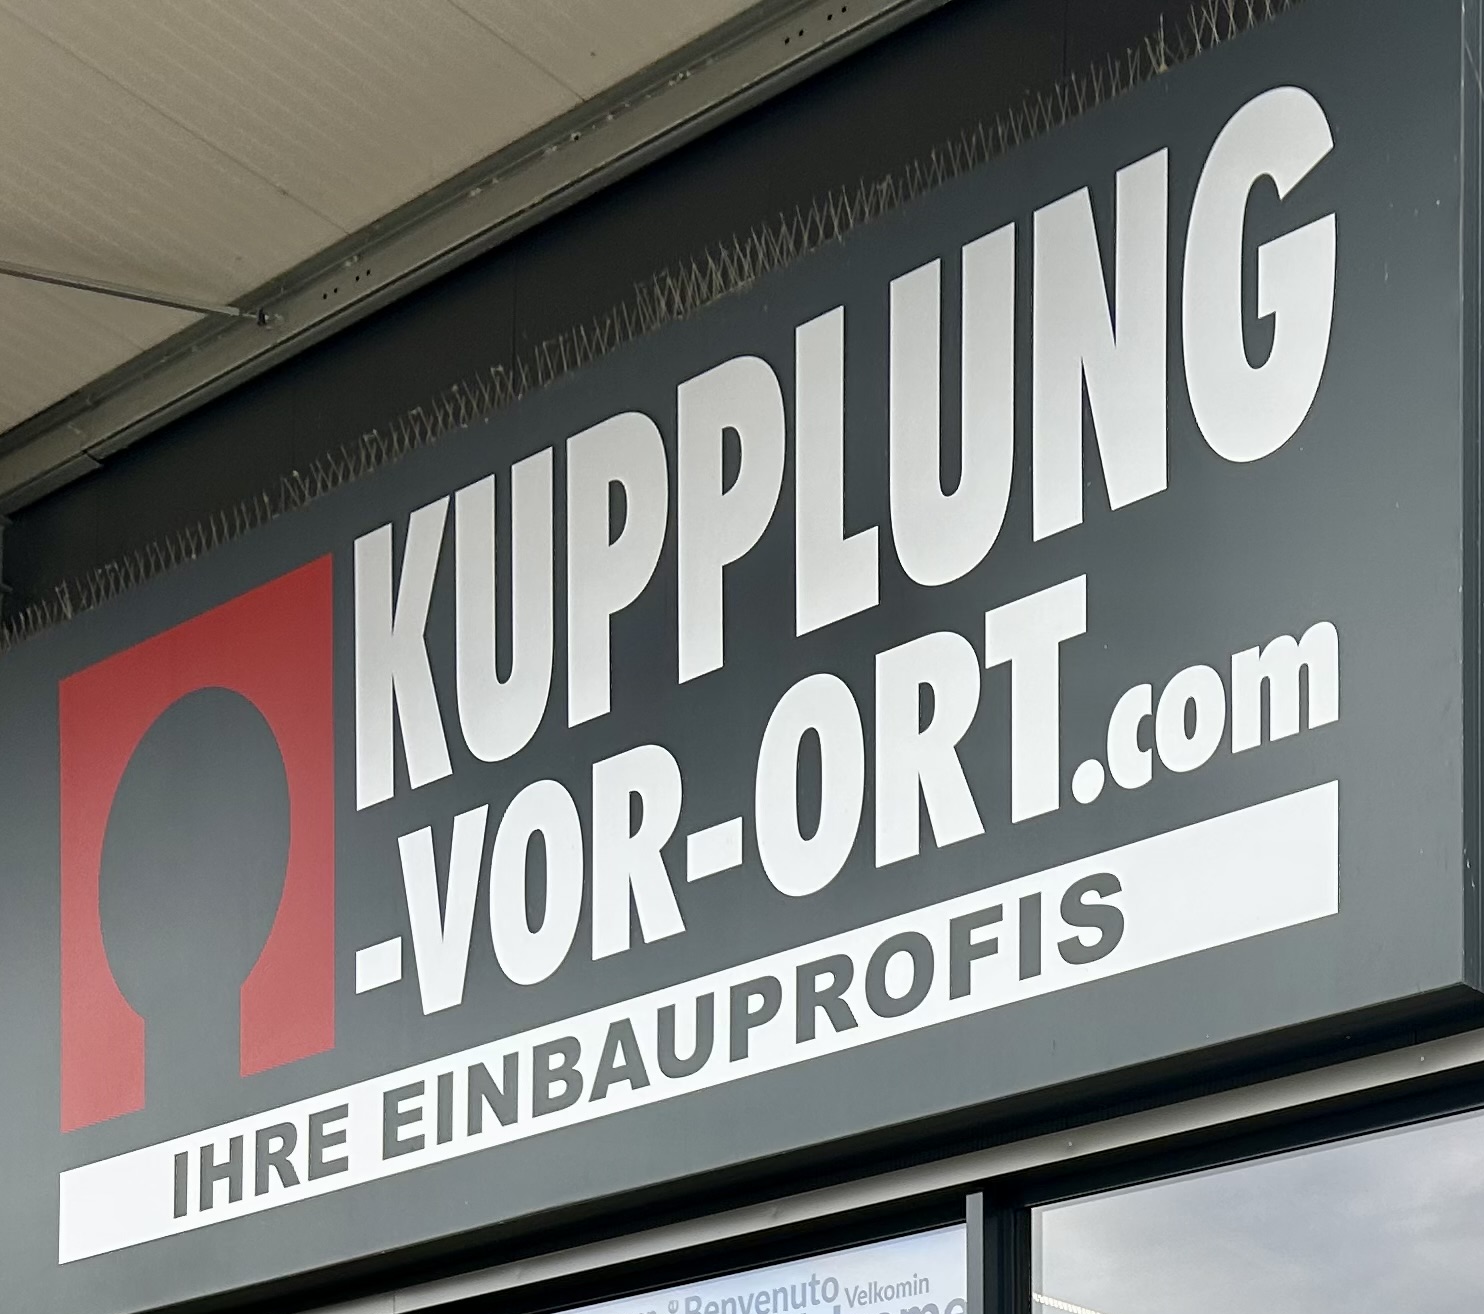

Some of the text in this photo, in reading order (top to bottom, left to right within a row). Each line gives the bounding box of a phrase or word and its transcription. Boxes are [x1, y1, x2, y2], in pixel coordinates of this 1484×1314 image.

[354, 85, 1337, 811] KUPPLUNG
[355, 574, 1339, 1016] -VOR-ORT.com
[172, 870, 1127, 1219] IHRE EINBAUPROFIS
[845, 1274, 930, 1308] Velkomin
